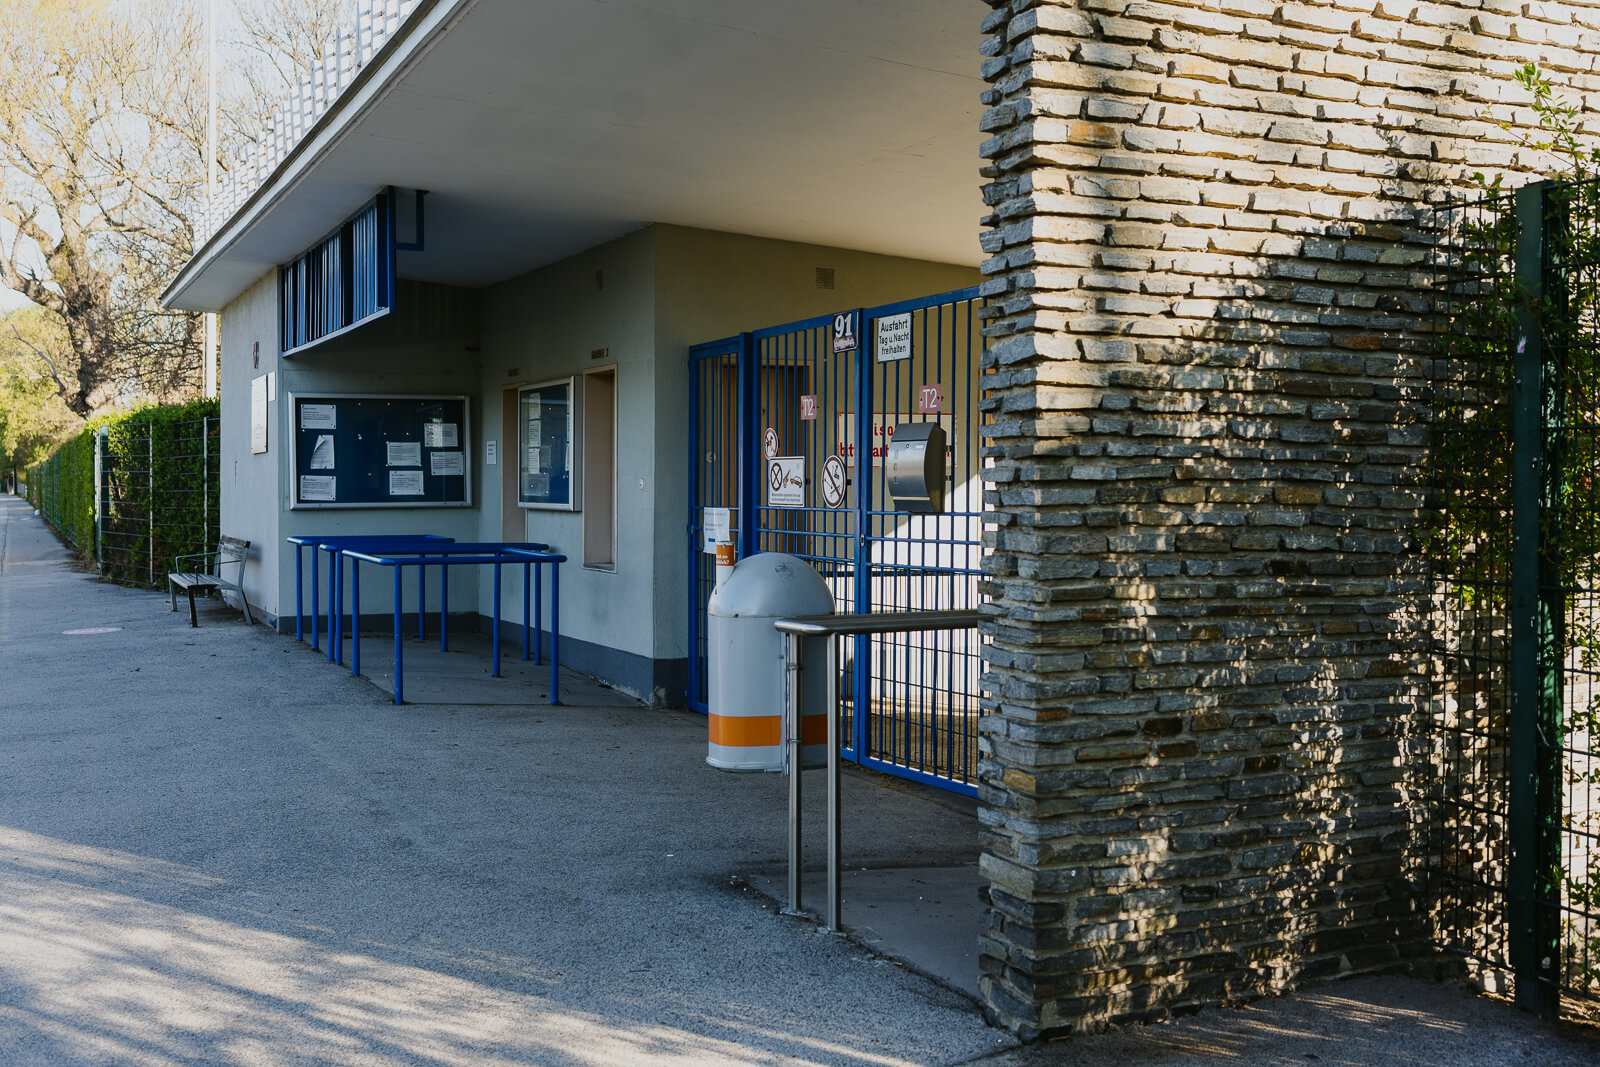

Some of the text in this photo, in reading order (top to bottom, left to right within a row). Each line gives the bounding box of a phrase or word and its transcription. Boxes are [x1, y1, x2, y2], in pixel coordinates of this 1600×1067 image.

[835, 313, 852, 338] 91
[880, 319, 908, 333] Ausfahrt
[879, 335, 888, 346] Tag
[894, 332, 909, 342] Nacht
[881, 344, 906, 355] freihalten
[922, 388, 938, 409] T2
[802, 398, 814, 416] T2
